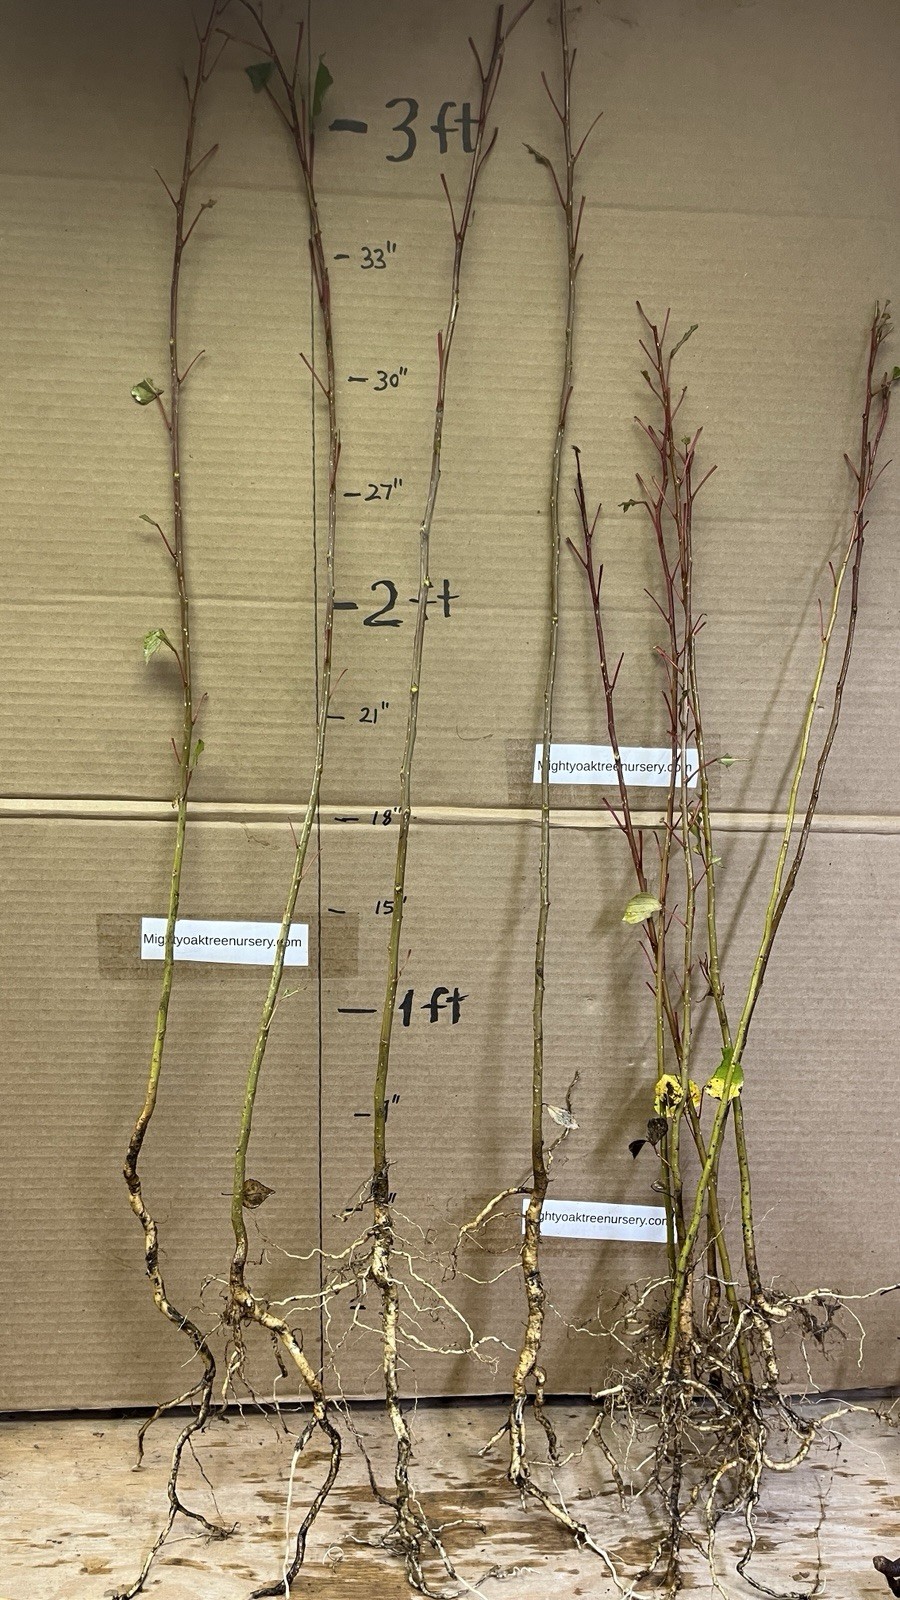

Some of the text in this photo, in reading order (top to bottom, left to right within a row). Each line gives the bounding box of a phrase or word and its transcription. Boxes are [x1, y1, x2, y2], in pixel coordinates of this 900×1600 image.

[385, 97, 480, 162] 3 ft
[360, 240, 397, 269] 33"
[373, 366, 408, 391] 30"
[364, 477, 403, 501] 27"
[363, 580, 404, 627] 2
[359, 701, 389, 724] 21"
[372, 806, 402, 826] 18"
[398, 986, 469, 1027] 1 ft
